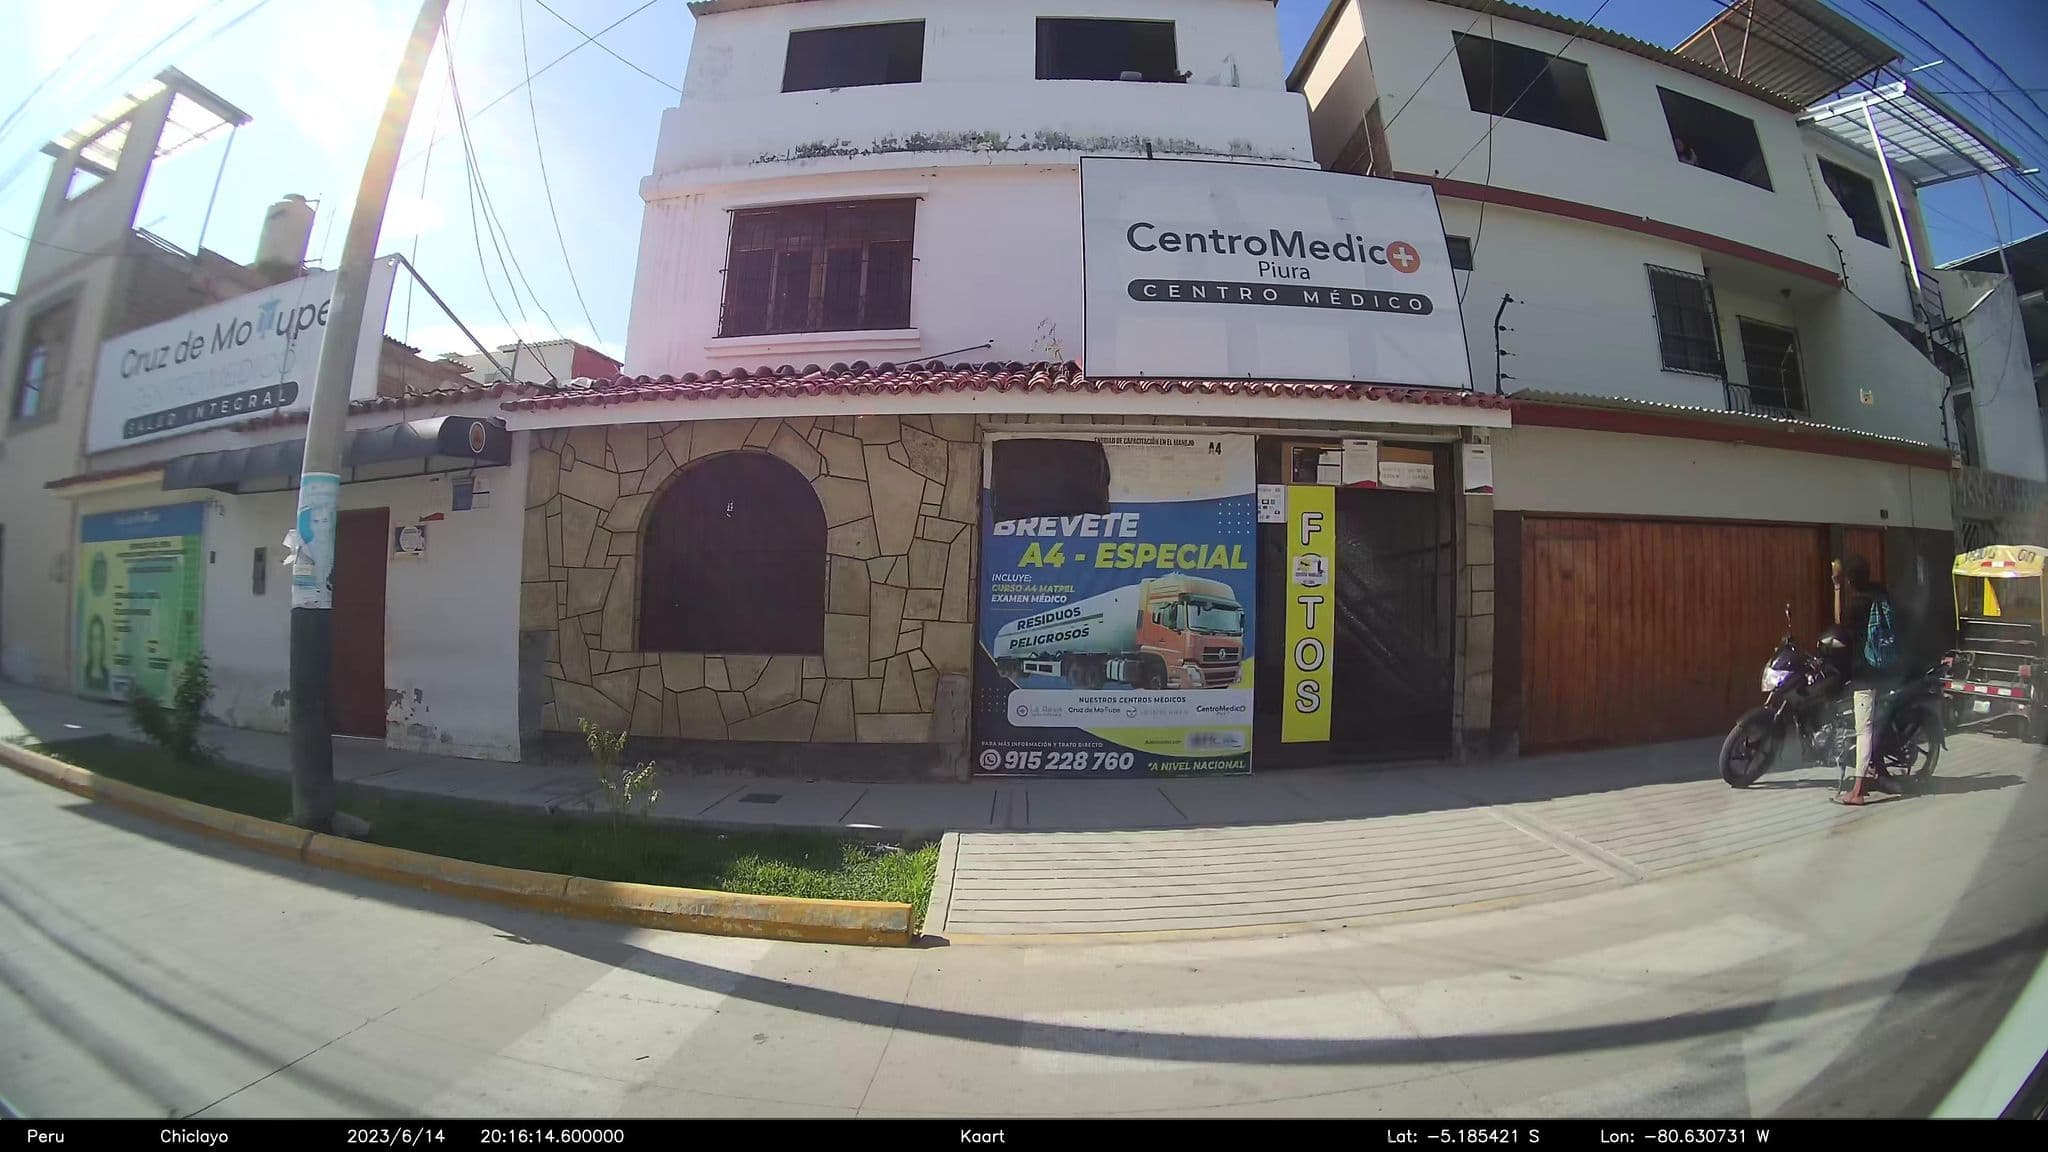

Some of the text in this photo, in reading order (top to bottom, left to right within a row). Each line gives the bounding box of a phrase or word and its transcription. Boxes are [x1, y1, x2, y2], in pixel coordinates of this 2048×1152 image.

[1258, 261, 1311, 280] Piura
[1143, 283, 1423, 312] CENTRO MÉDICO
[120, 347, 170, 378] Cruz
[174, 331, 204, 364] de
[187, 389, 287, 419] INTEGRAL
[1208, 441, 1222, 455] A4
[1017, 542, 1066, 568] A4
[1095, 543, 1248, 569] ESPECIAL
[992, 573, 1033, 582] INCLUYE:
[991, 584, 1023, 592] CURSO
[991, 592, 1068, 603] EXAMEN MÉDICO
[1017, 607, 1081, 631] RESIDUOS
[1294, 512, 1325, 713] FTOS
[1009, 627, 1090, 649] PELIGROSOS
[1004, 751, 1135, 770] 915 228 760
[1160, 762, 1190, 771] NIVEL
[1193, 761, 1245, 771] NACIONAL
